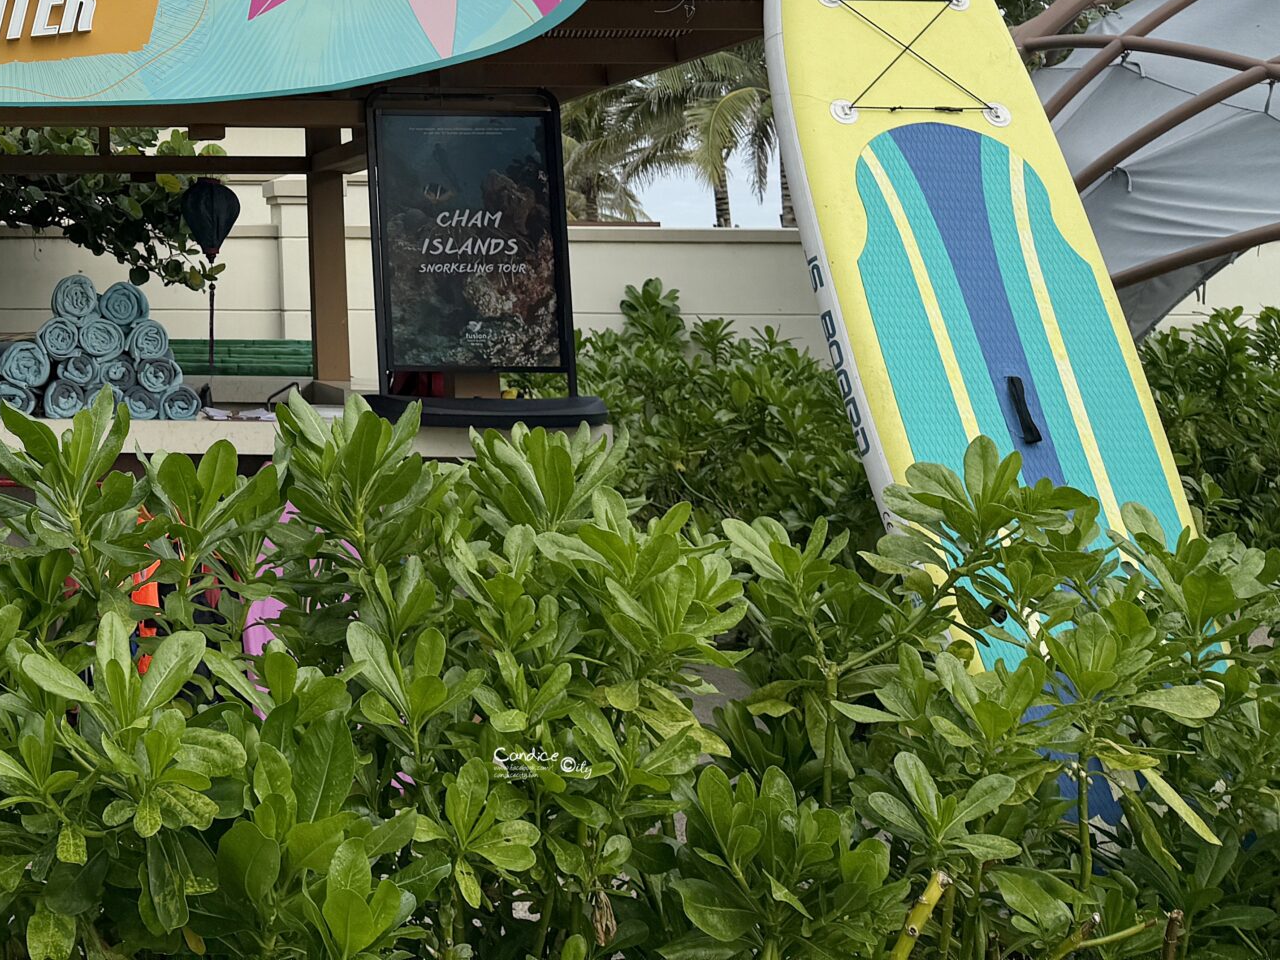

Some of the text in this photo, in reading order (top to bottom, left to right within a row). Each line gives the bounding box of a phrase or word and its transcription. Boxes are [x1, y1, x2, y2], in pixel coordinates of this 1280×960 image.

[436, 208, 503, 228] CHAM
[421, 237, 519, 256] ISLANDS
[419, 262, 527, 274] SNORKELING TOUR
[820, 309, 871, 458] BOARD
